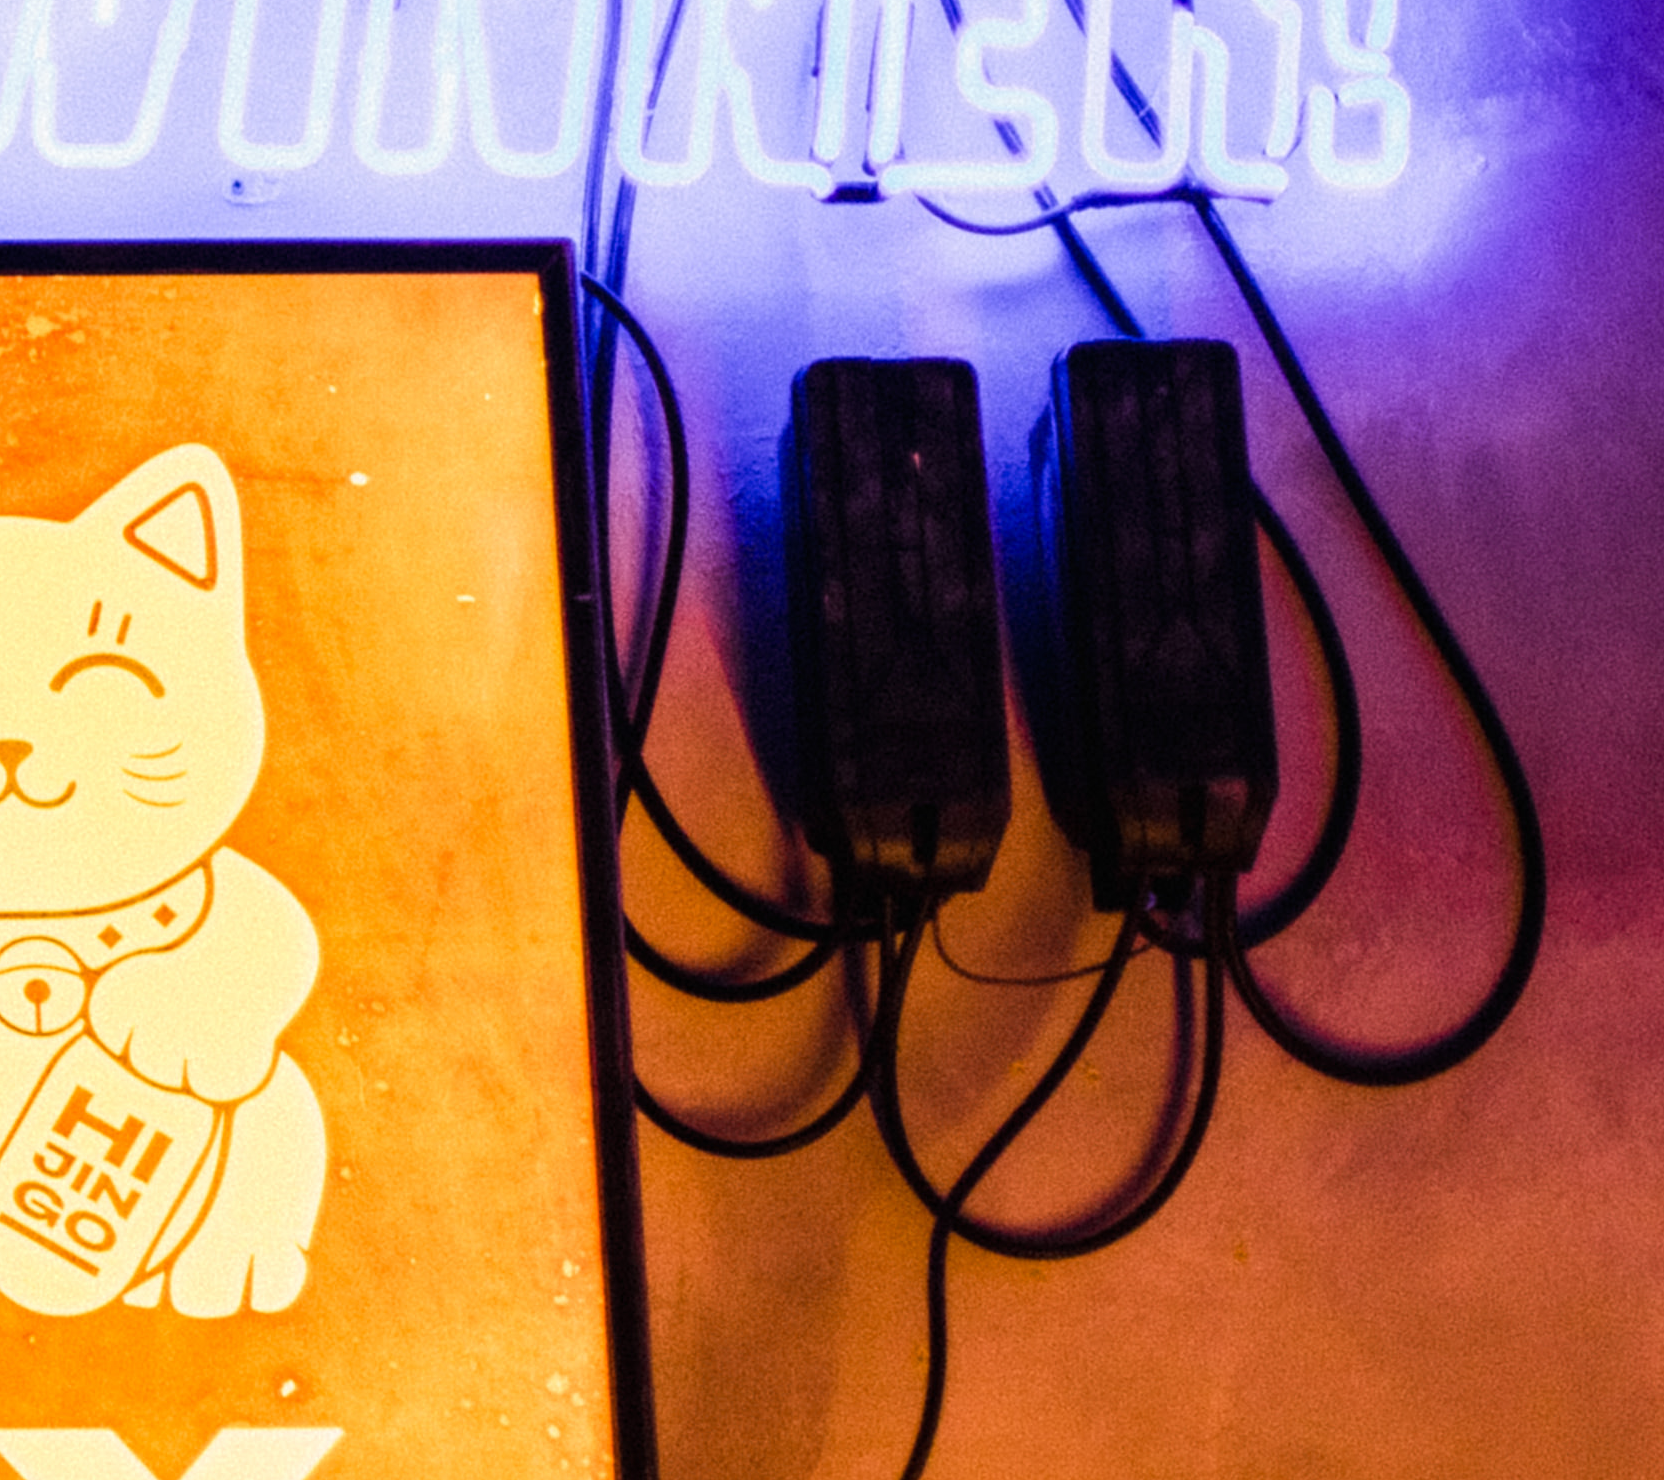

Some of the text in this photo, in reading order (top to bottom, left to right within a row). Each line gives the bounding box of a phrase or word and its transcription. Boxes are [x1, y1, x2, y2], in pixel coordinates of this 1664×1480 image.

[51, 1085, 174, 1184] HI
[13, 1180, 117, 1253] GO
[33, 1141, 141, 1220] JIN
